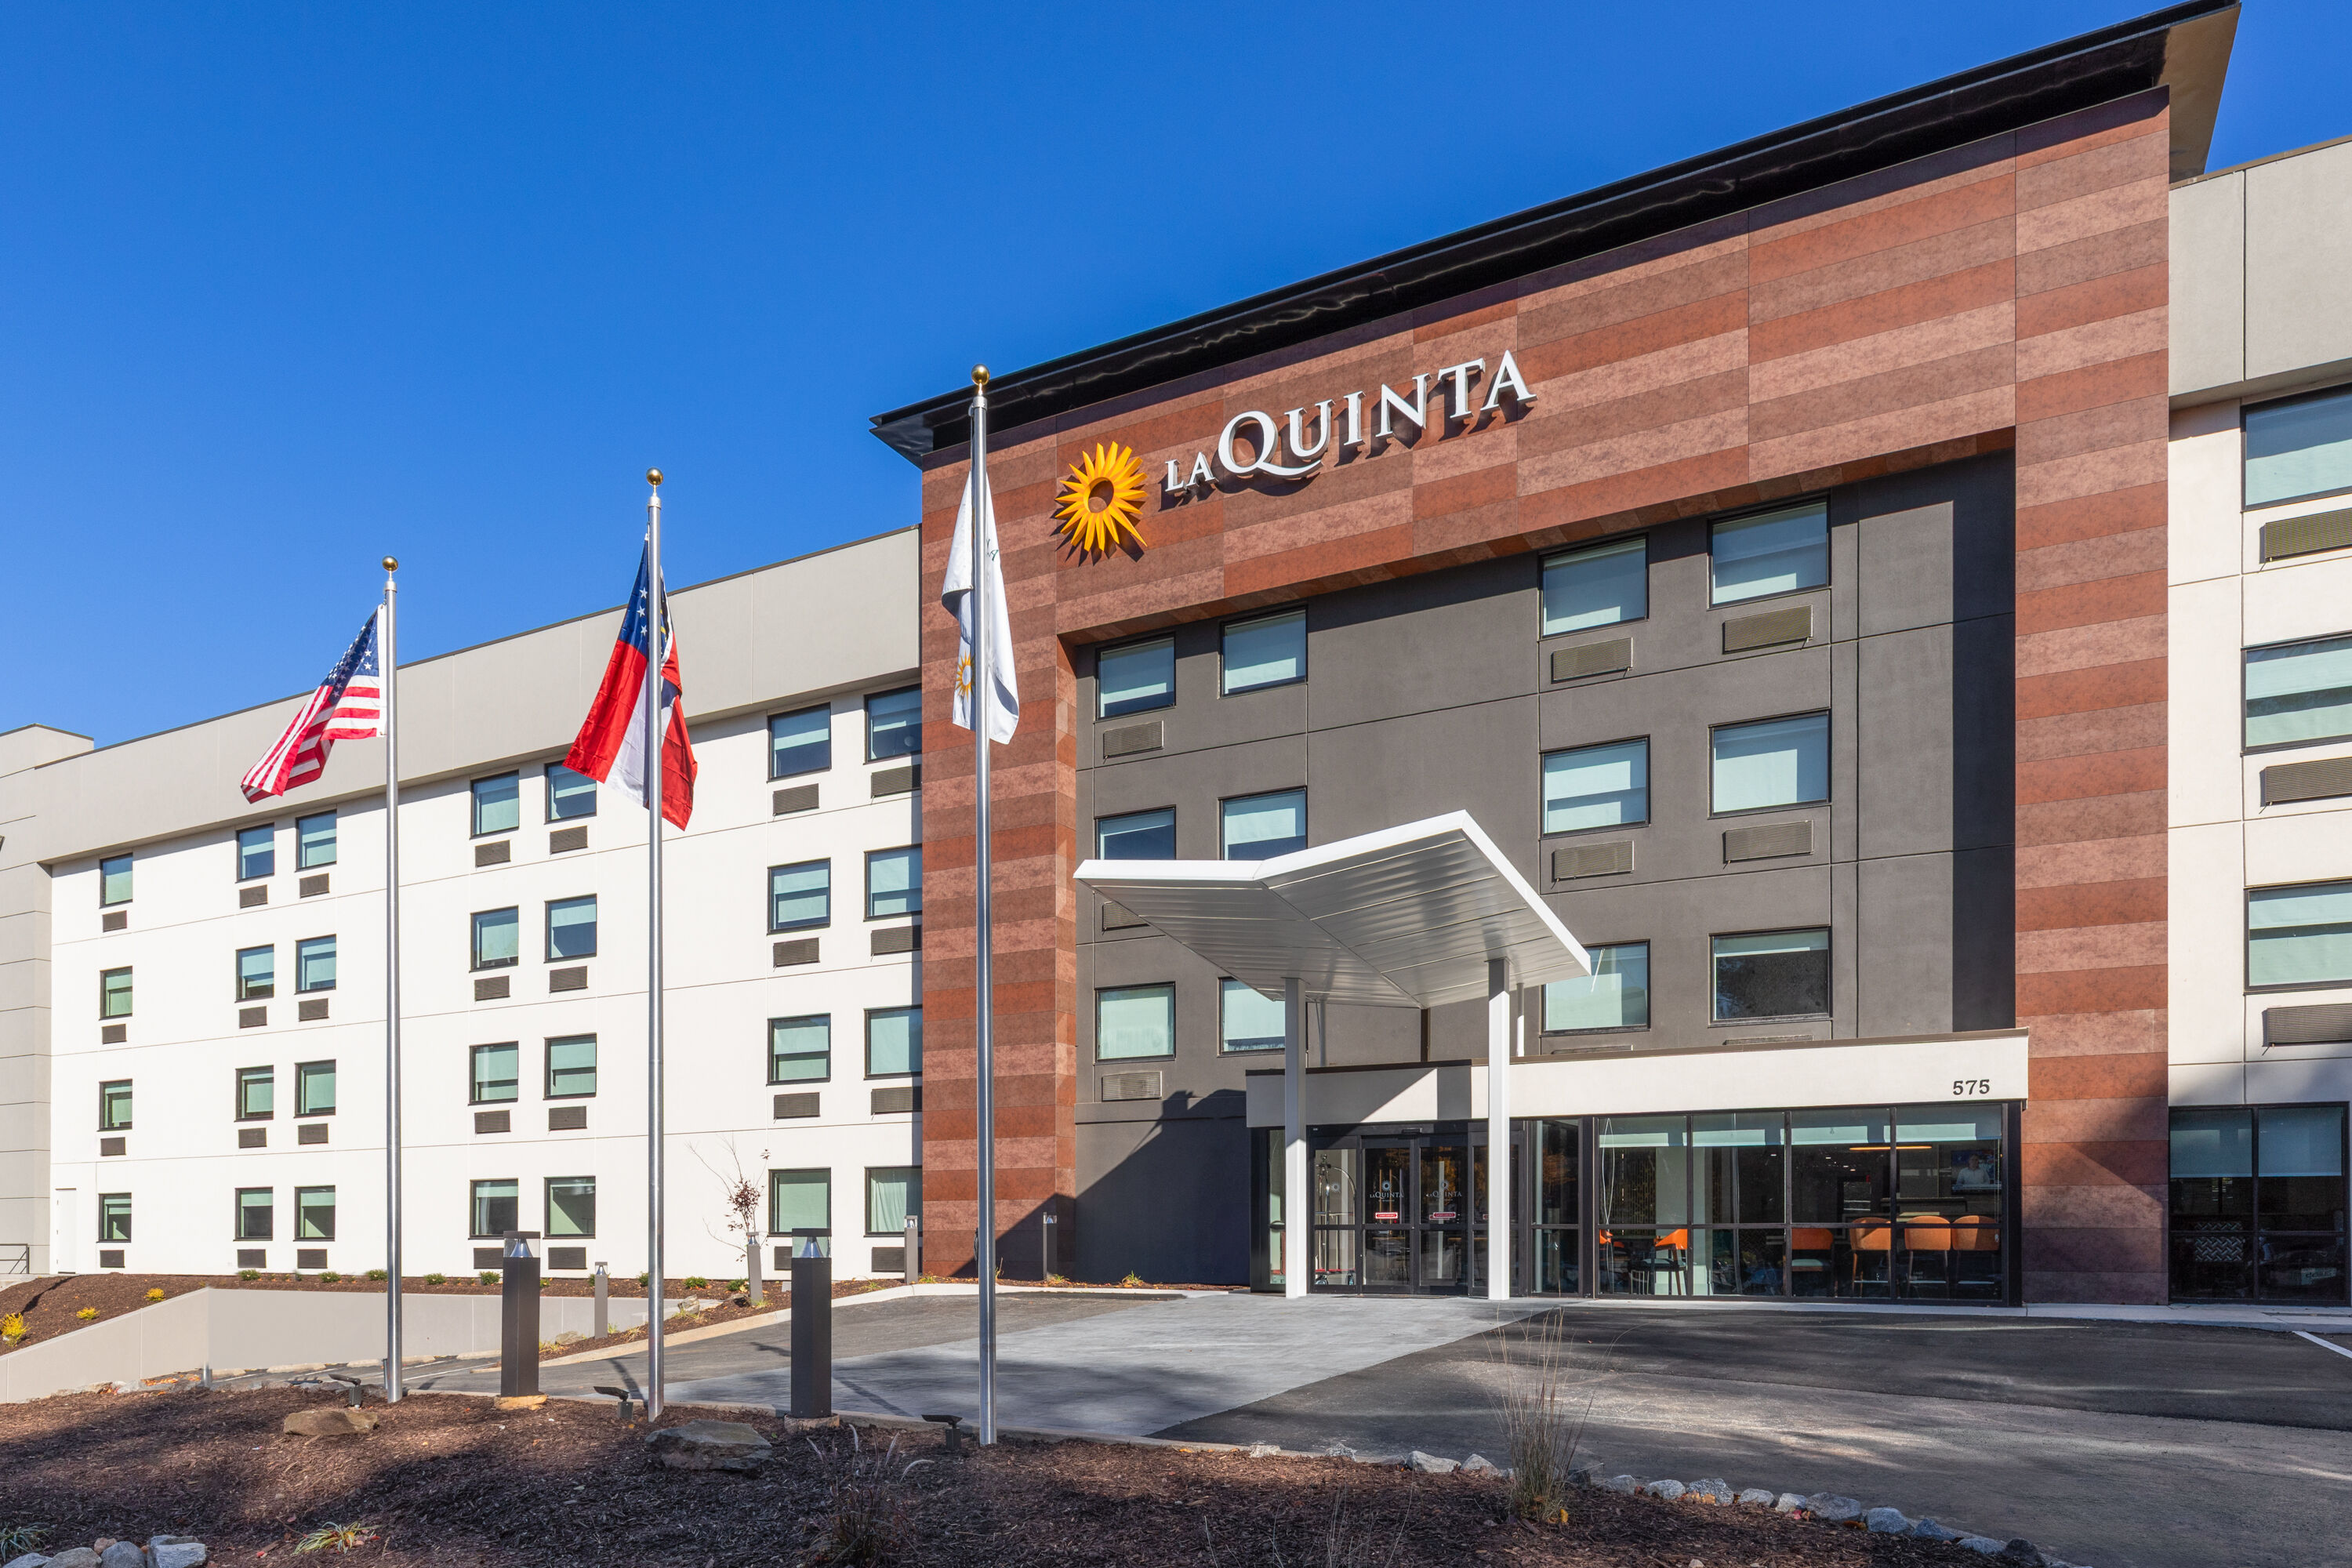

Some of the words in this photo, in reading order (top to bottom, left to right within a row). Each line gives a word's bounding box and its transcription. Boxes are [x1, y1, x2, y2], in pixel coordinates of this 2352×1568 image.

[1165, 451, 1218, 494] LA
[1218, 350, 1538, 477] QUINTA
[1953, 1079, 1990, 1095] 575
[1375, 1191, 1404, 1200] QUINTA
